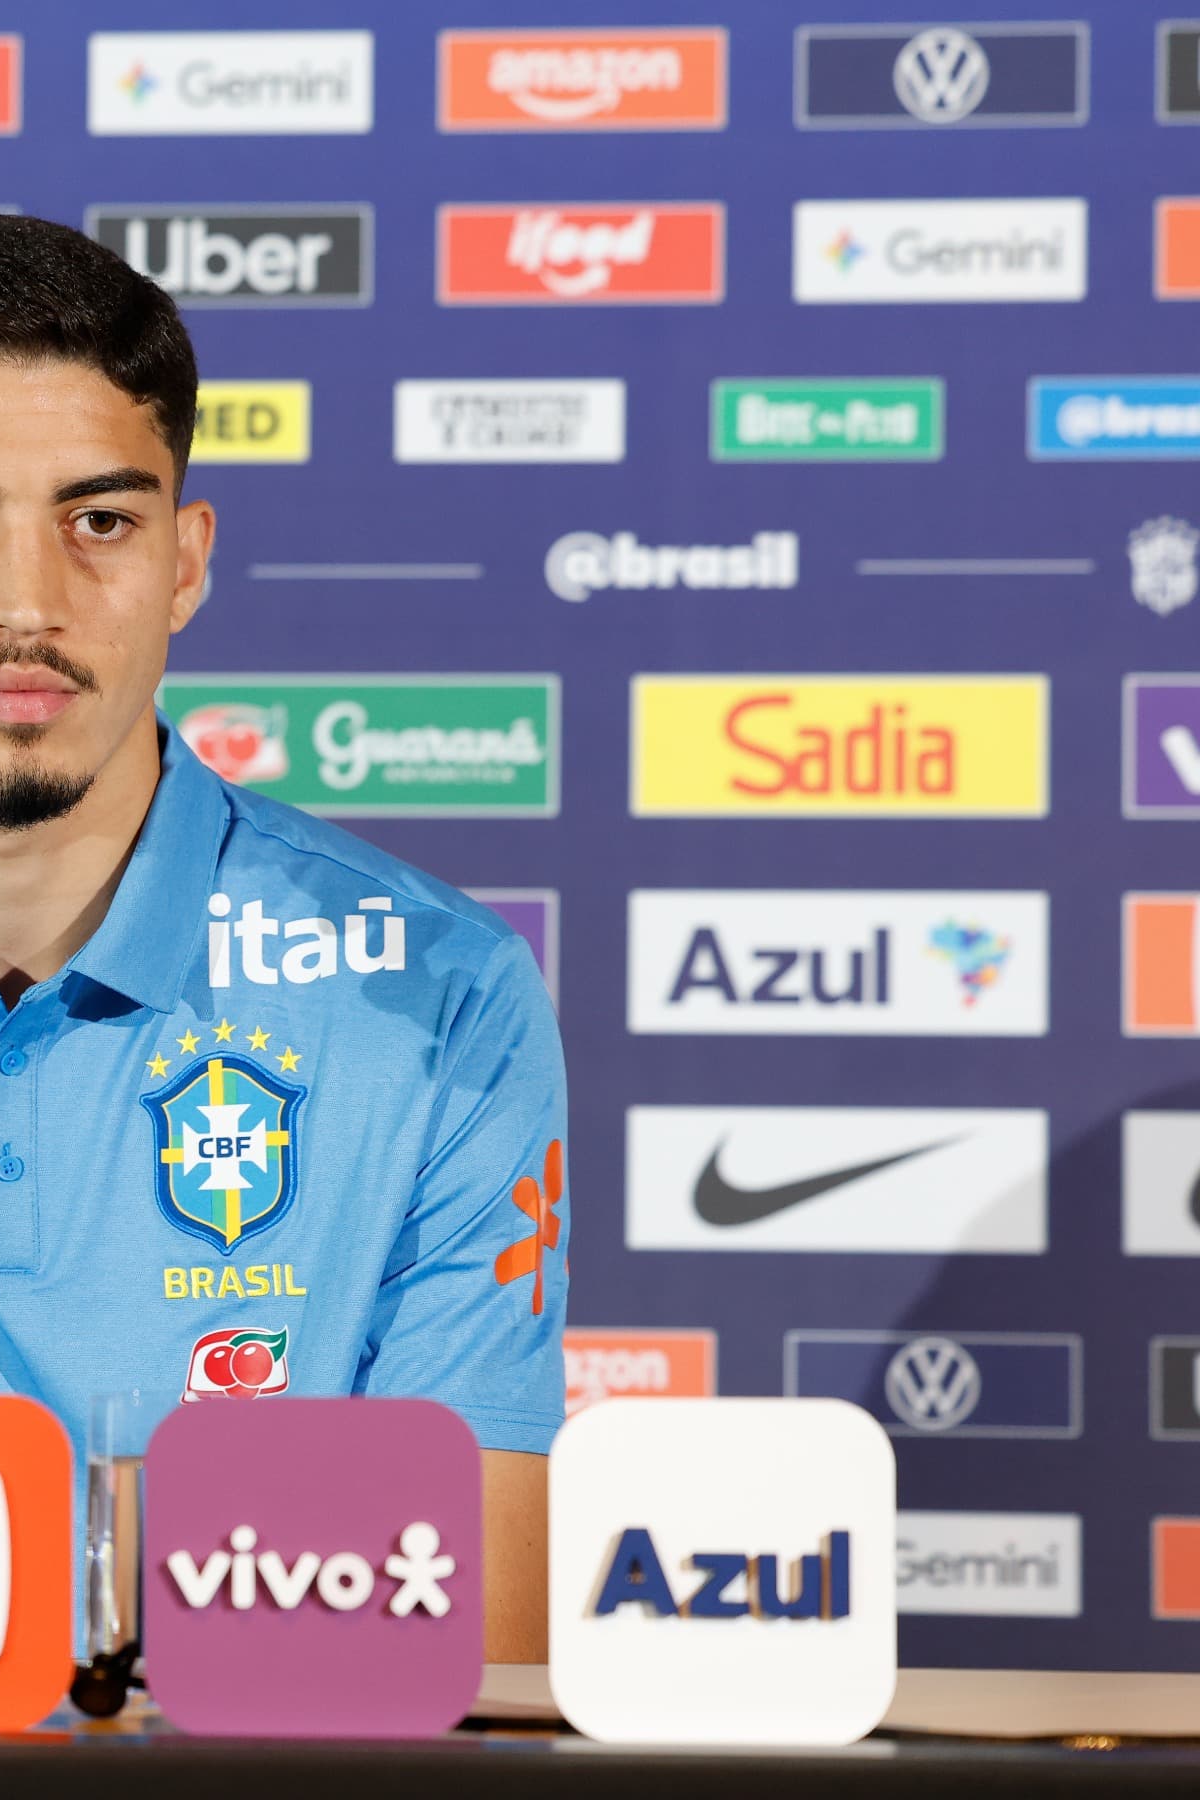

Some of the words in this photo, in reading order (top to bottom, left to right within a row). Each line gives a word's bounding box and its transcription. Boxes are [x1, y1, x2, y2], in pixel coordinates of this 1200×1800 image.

[178, 63, 350, 105] Gemini
[487, 49, 681, 107] amazon
[125, 219, 332, 294] Uber
[884, 228, 1063, 275] Gemini
[1056, 394, 1200, 447] @bras
[544, 532, 799, 600] @brasil
[311, 699, 546, 790] Guaraná
[723, 693, 956, 797] Sadia
[207, 891, 405, 988] itaú
[667, 926, 890, 1006] Azul
[198, 1136, 251, 1159] CBF
[163, 1263, 308, 1299] BRASIL
[565, 1347, 669, 1397] azon
[166, 1525, 376, 1611] vivo
[587, 1527, 851, 1620] Azul
